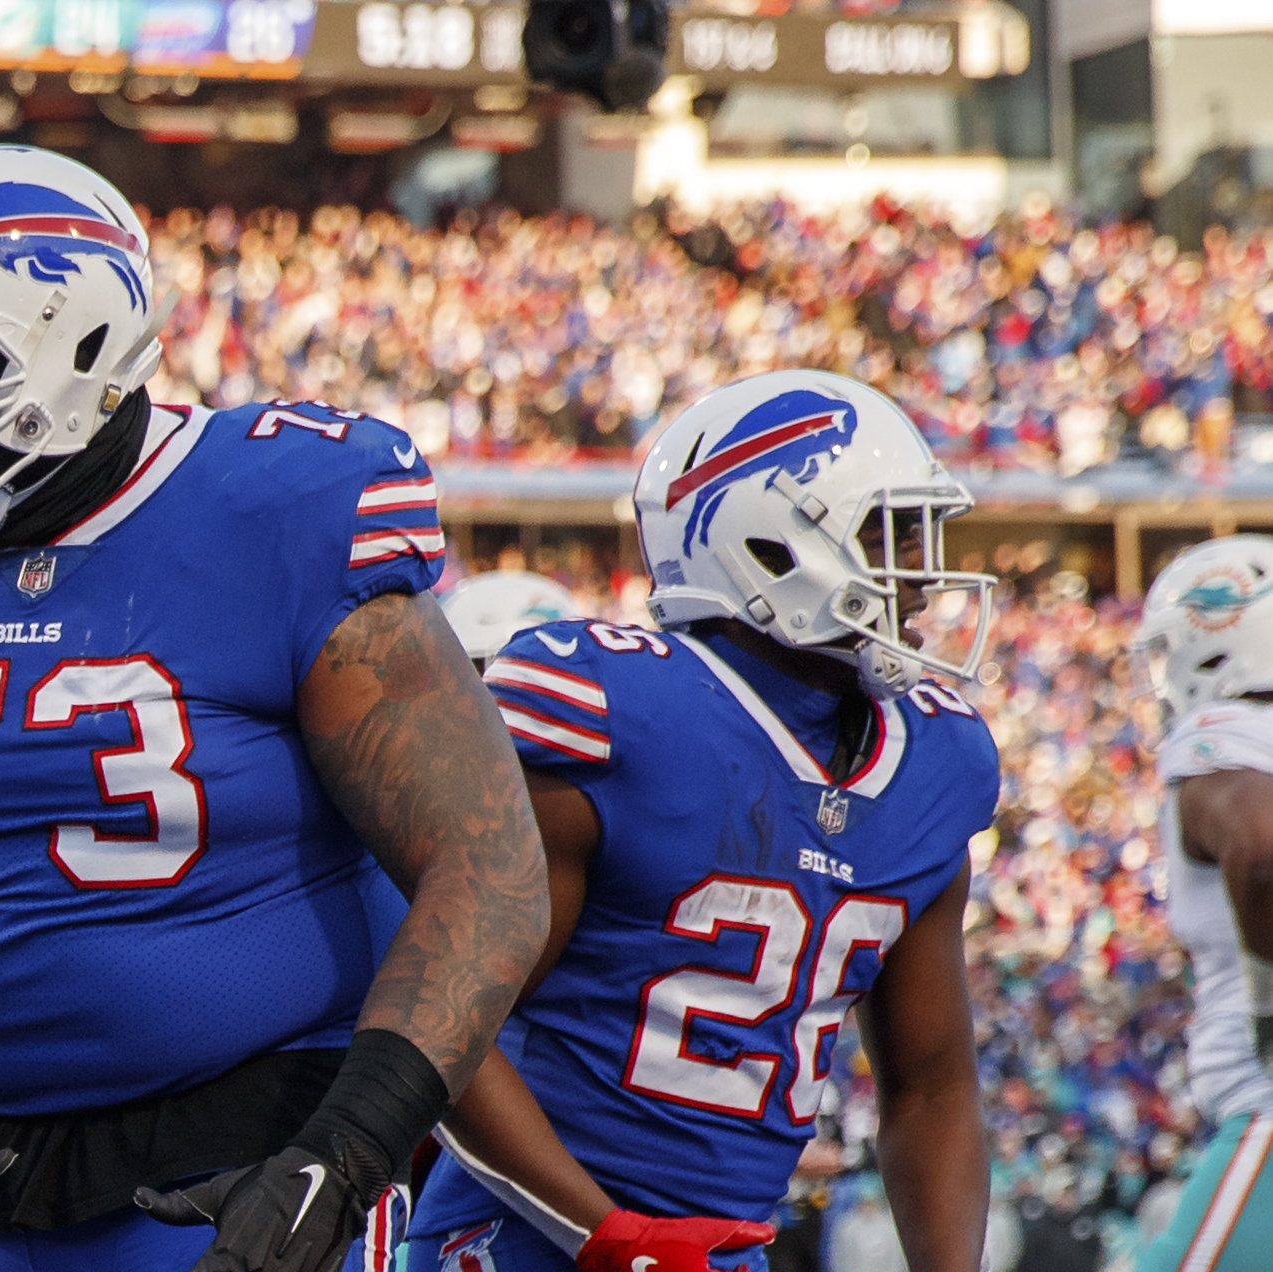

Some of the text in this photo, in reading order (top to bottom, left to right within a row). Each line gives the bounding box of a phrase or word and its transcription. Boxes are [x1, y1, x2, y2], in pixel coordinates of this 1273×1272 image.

[21, 571, 47, 589] NFL
[798, 848, 854, 884] BILLS
[623, 873, 908, 1125] 26
